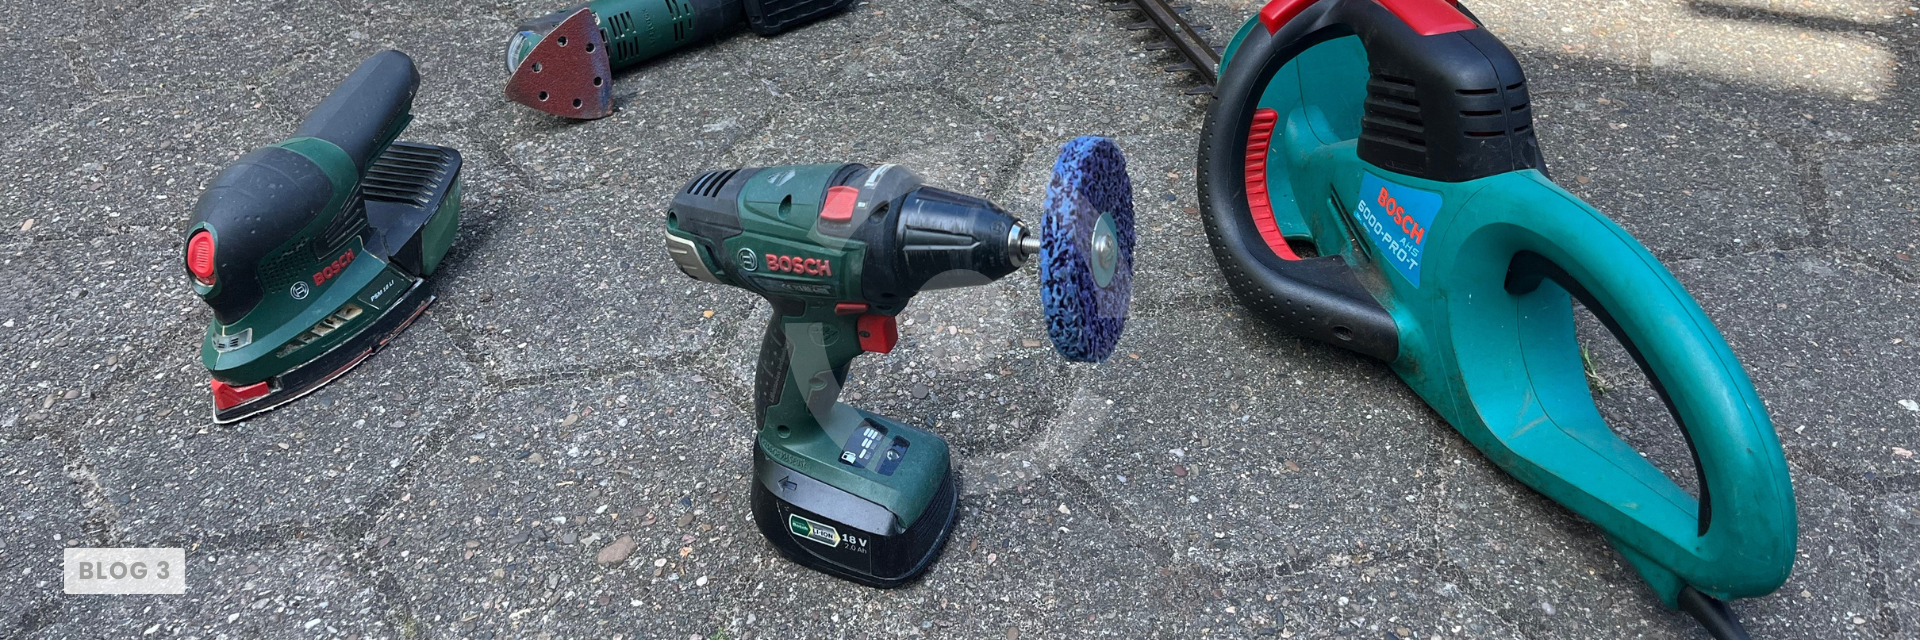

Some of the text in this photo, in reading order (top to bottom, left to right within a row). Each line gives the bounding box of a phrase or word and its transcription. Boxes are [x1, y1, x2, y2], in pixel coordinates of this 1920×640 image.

[1378, 186, 1425, 245] BOSCH
[1358, 199, 1419, 270] 6000-PRO-T
[1399, 237, 1420, 257] AHS
[312, 247, 355, 287] BOSCH
[765, 253, 832, 277] BOSCH
[842, 533, 868, 547] 18 V
[844, 543, 867, 555] 2.0 Ah
